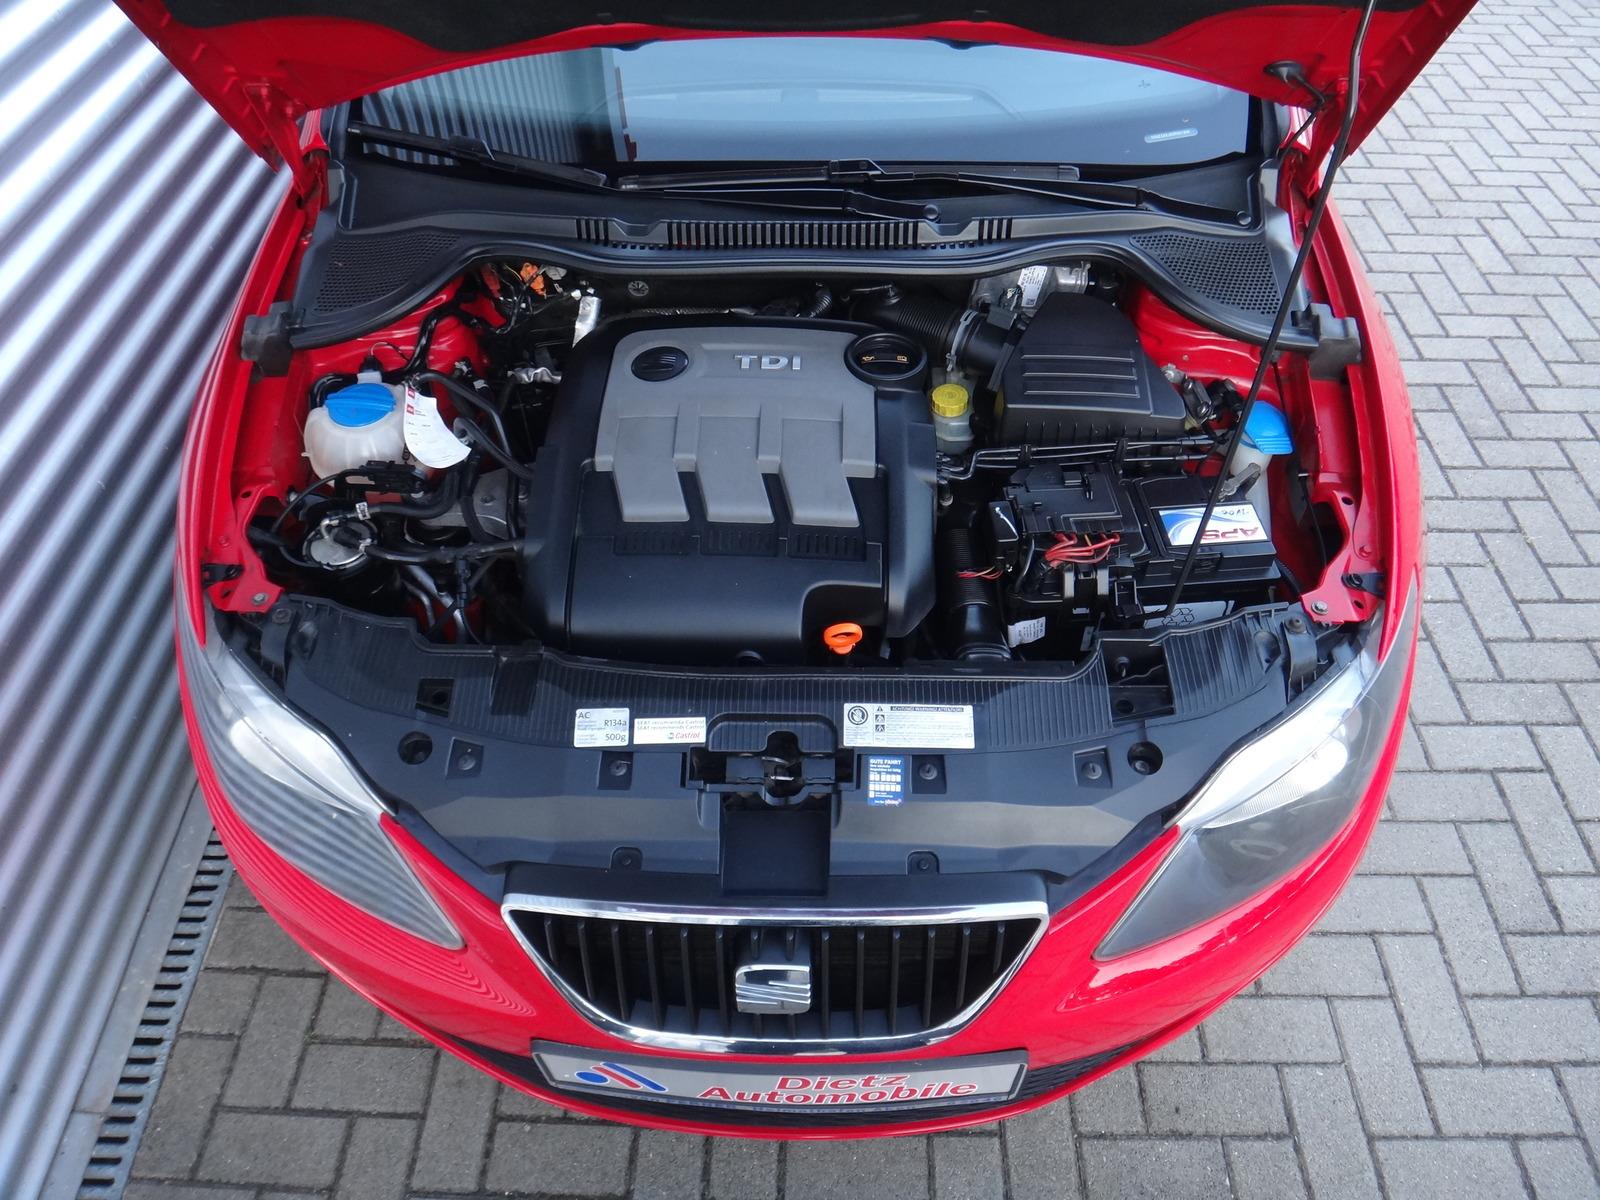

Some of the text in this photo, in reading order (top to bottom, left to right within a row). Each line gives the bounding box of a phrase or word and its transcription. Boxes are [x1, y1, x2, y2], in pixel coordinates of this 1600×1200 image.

[735, 355, 801, 369] TDI
[578, 711, 591, 719] AC
[604, 719, 627, 727] R134a
[605, 733, 627, 743] 500g
[675, 732, 700, 740] Castrol
[775, 1075, 910, 1091] Dietz
[696, 1082, 979, 1105] Automobile
